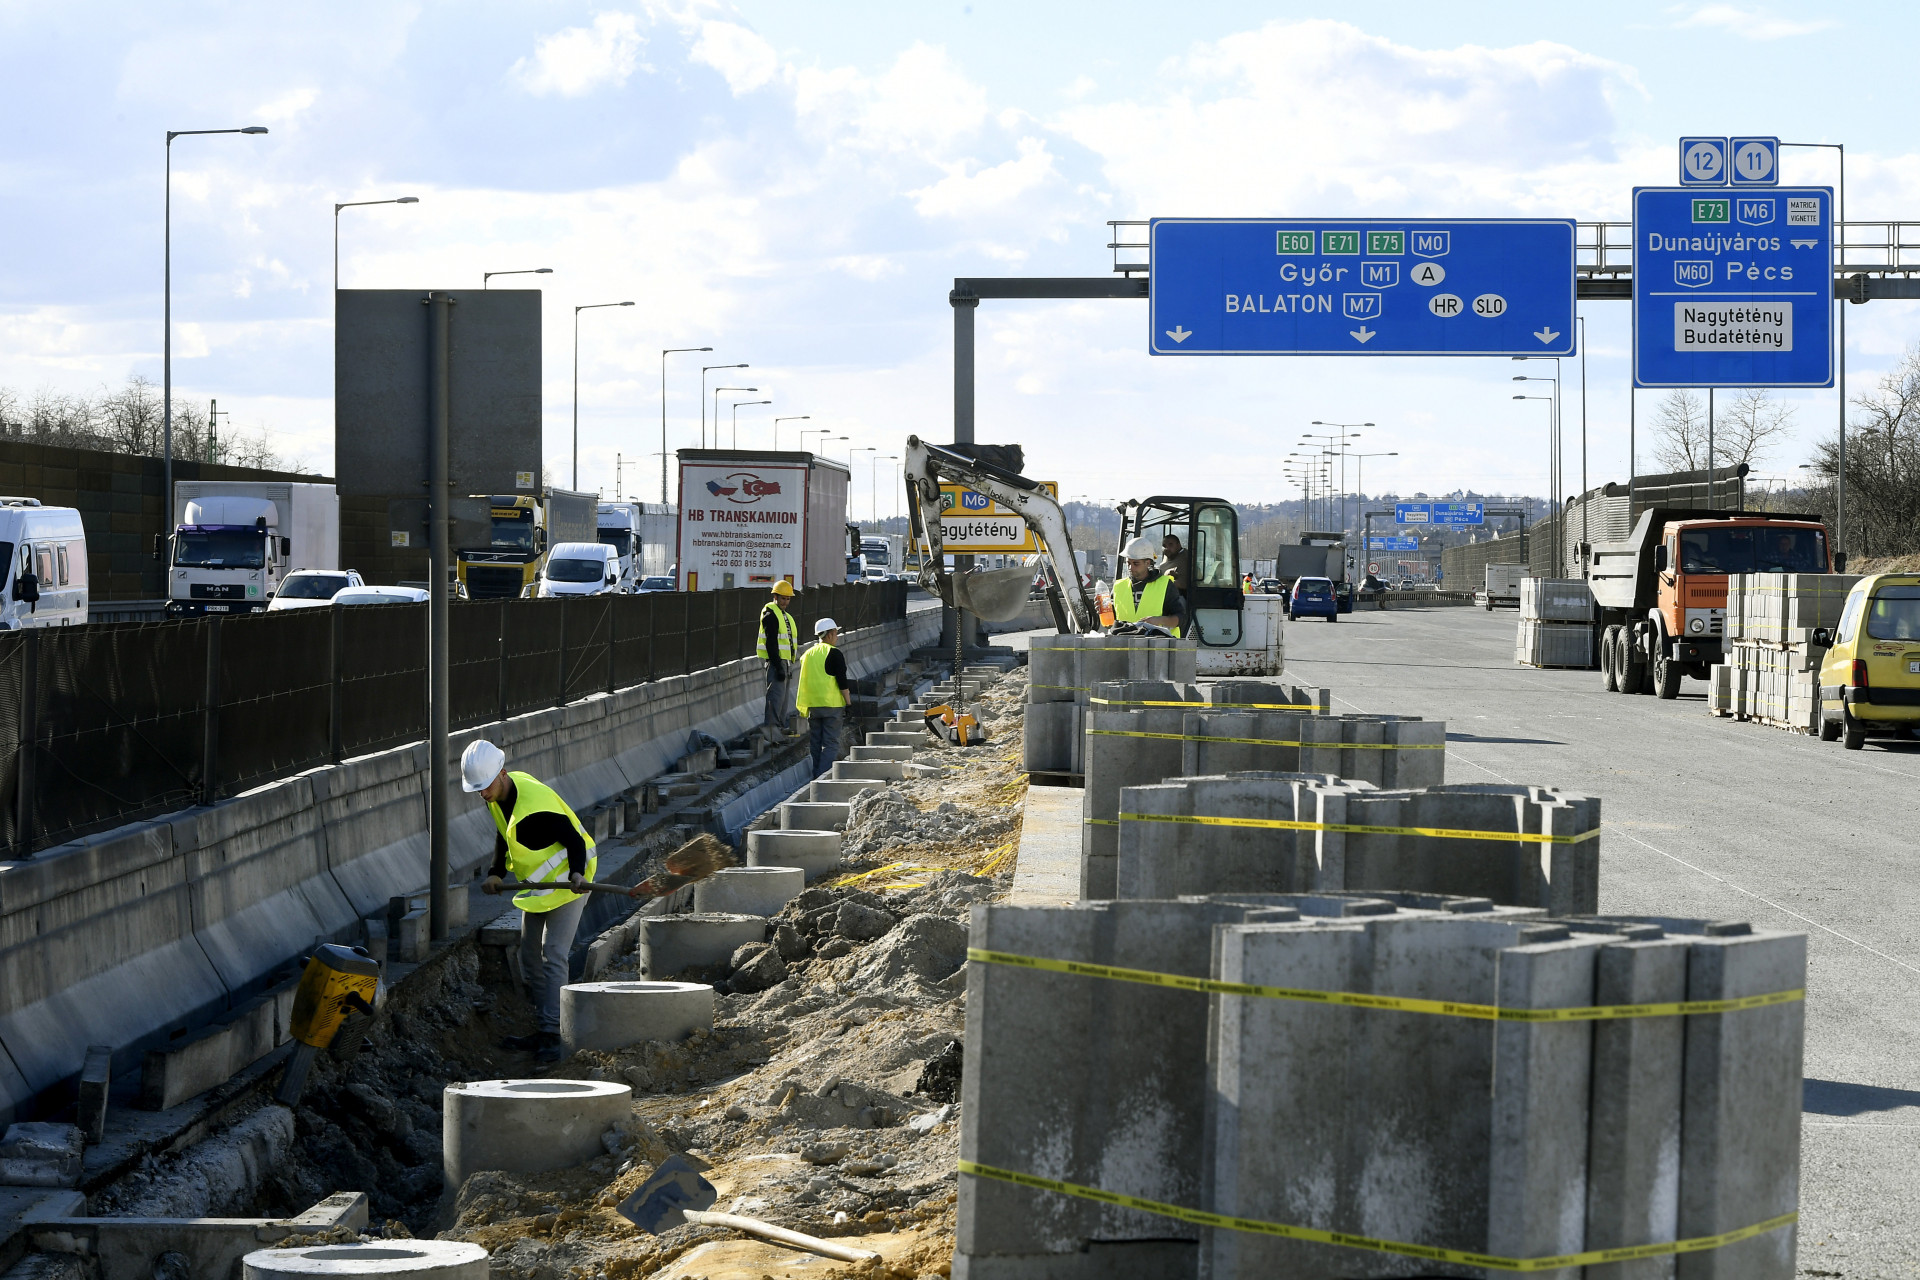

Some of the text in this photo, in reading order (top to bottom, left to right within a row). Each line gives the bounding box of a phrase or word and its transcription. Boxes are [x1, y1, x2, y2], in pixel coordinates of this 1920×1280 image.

[1693, 152, 1713, 170] 12
[1746, 152, 1762, 170] 11
[1698, 204, 1768, 218] E73 M6
[1790, 201, 1817, 209] MATRICA
[1790, 214, 1817, 223] VIGNETTE
[1282, 236, 1443, 251] E60 E71 E75 M0
[1649, 232, 1781, 255] Dunaújváros
[1279, 263, 1435, 287] Győr M1 A
[1679, 262, 1794, 281] M60 Pécs
[1225, 294, 1502, 313] BALATON M7 HR SLO
[1684, 308, 1783, 326] Nagytétény
[1684, 328, 1783, 347] Budatétény
[965, 494, 986, 506] M6
[688, 509, 798, 524] HB TRANSKAMION
[701, 531, 783, 540] www.hbtranskamion.cz
[941, 522, 1017, 540] agytétény
[692, 539, 791, 549] hbtranskamion@seznam.cz
[711, 550, 728, 558] +420
[730, 550, 742, 558] 733
[744, 550, 757, 558] 712
